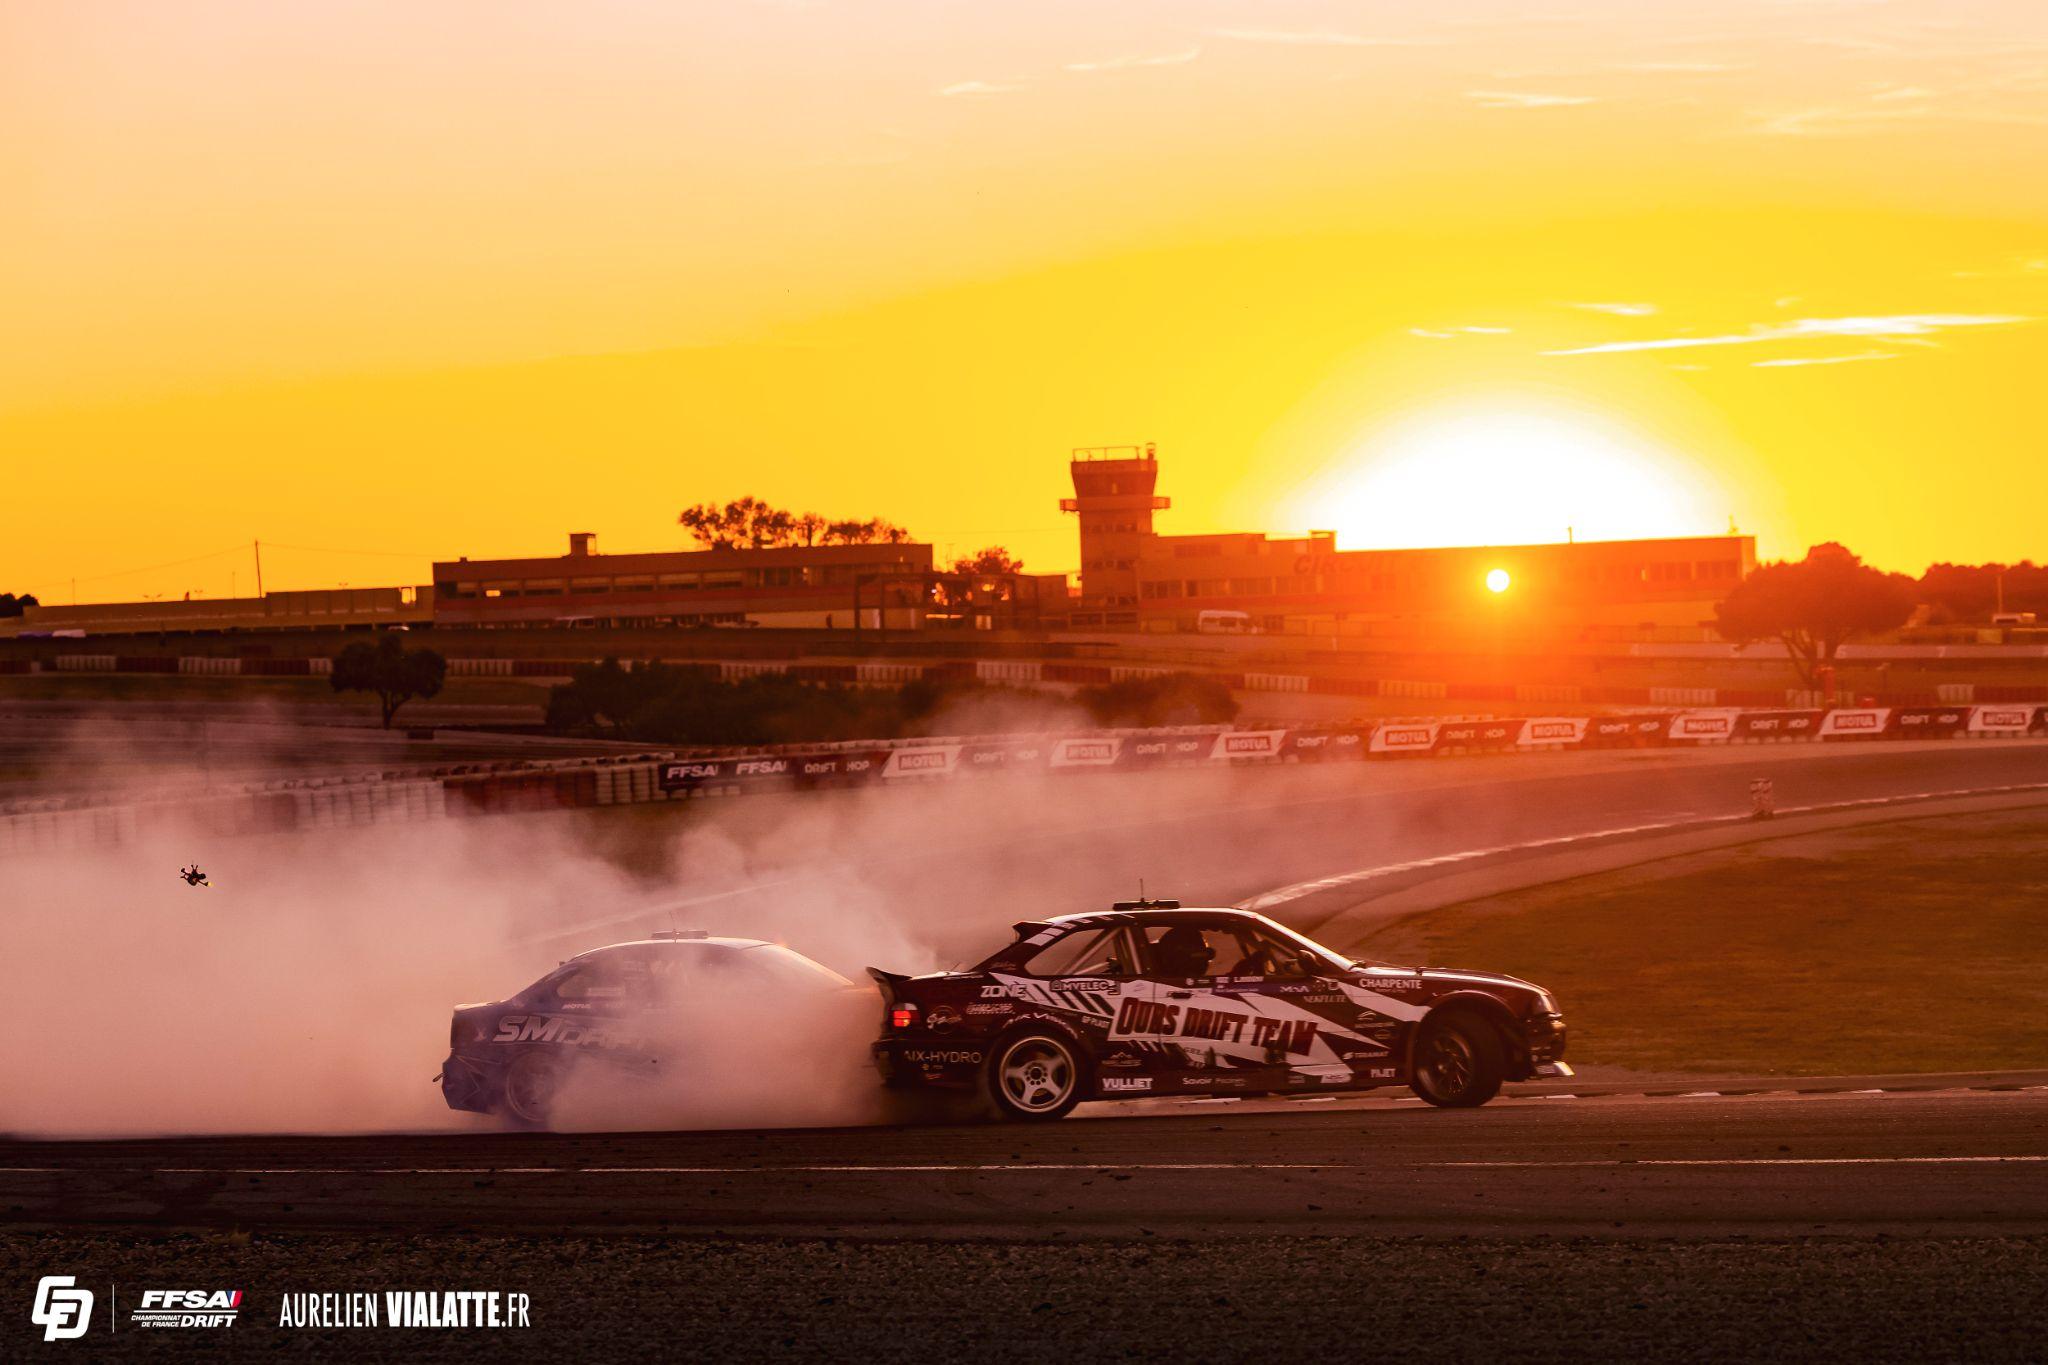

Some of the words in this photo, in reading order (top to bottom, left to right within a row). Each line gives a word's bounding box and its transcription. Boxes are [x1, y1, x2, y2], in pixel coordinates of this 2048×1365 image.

[1687, 719, 1727, 732] MOTUL
[1836, 715, 1874, 728] MOTUL
[1984, 713, 2025, 725] MOTUL
[1534, 724, 1575, 737] MOTUL
[1228, 738, 1269, 750] MOTUL
[1388, 731, 1428, 744] MOTUL
[1068, 746, 1109, 758] MOTUL
[736, 760, 785, 776] FFSA
[804, 762, 837, 774] DRIFT
[901, 755, 945, 768] MOTUL
[667, 764, 717, 779] FFSA
[1359, 978, 1423, 990] CHARPENTE
[980, 985, 1027, 998] ZONE
[1116, 997, 1180, 1036] OURS
[1181, 1007, 1249, 1044] DRIFT
[1250, 1016, 1319, 1057] TEAM
[1102, 1077, 1153, 1090] VULLIET
